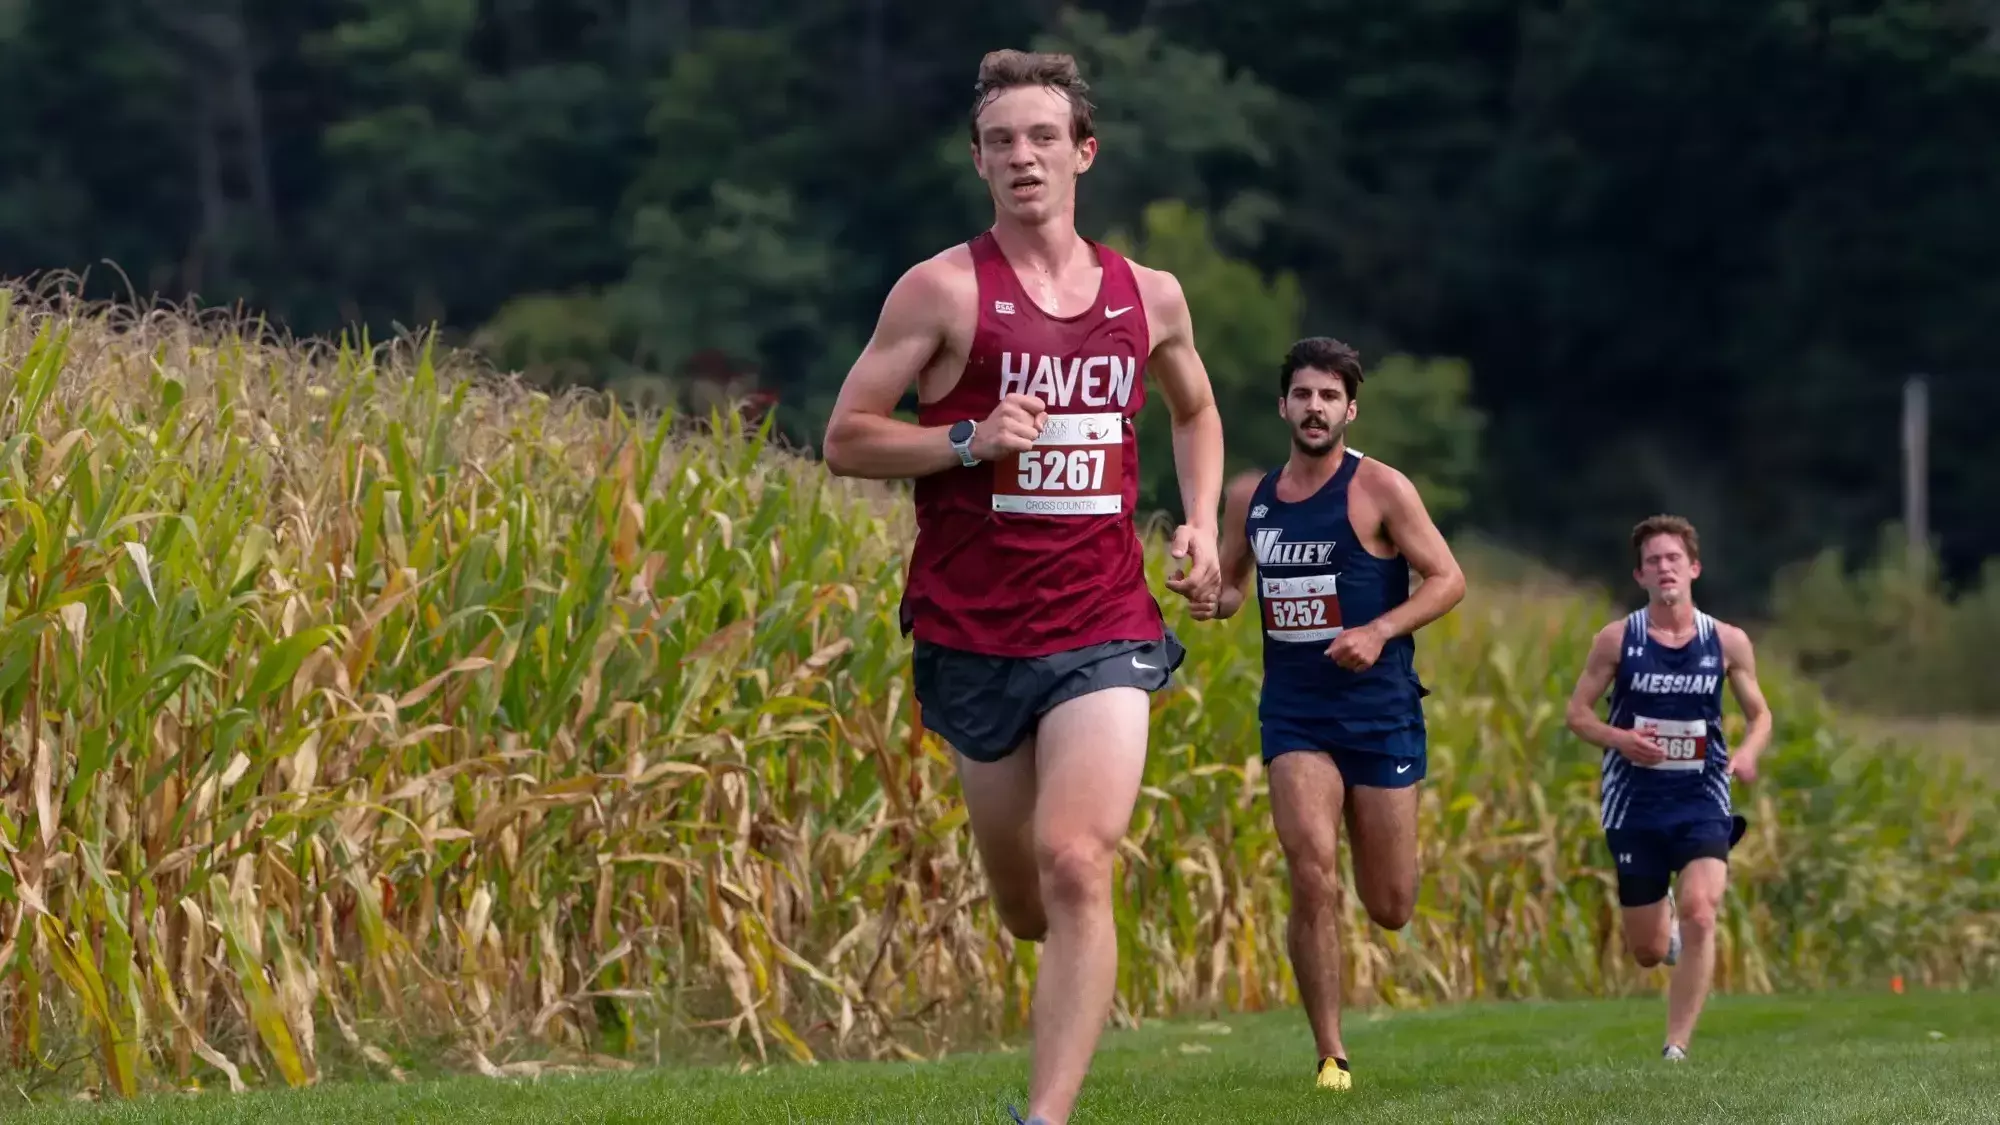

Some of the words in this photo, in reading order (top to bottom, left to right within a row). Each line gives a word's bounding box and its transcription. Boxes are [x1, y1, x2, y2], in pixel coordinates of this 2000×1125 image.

[1000, 352, 1136, 408] HAVEN
[1017, 449, 1106, 491] 5267
[1025, 500, 1056, 511] CROSS
[1056, 500, 1097, 511] COUNTRY
[1251, 528, 1336, 566] VALLEY
[1272, 599, 1328, 628] 5252
[1630, 672, 1719, 695] MESSIAH
